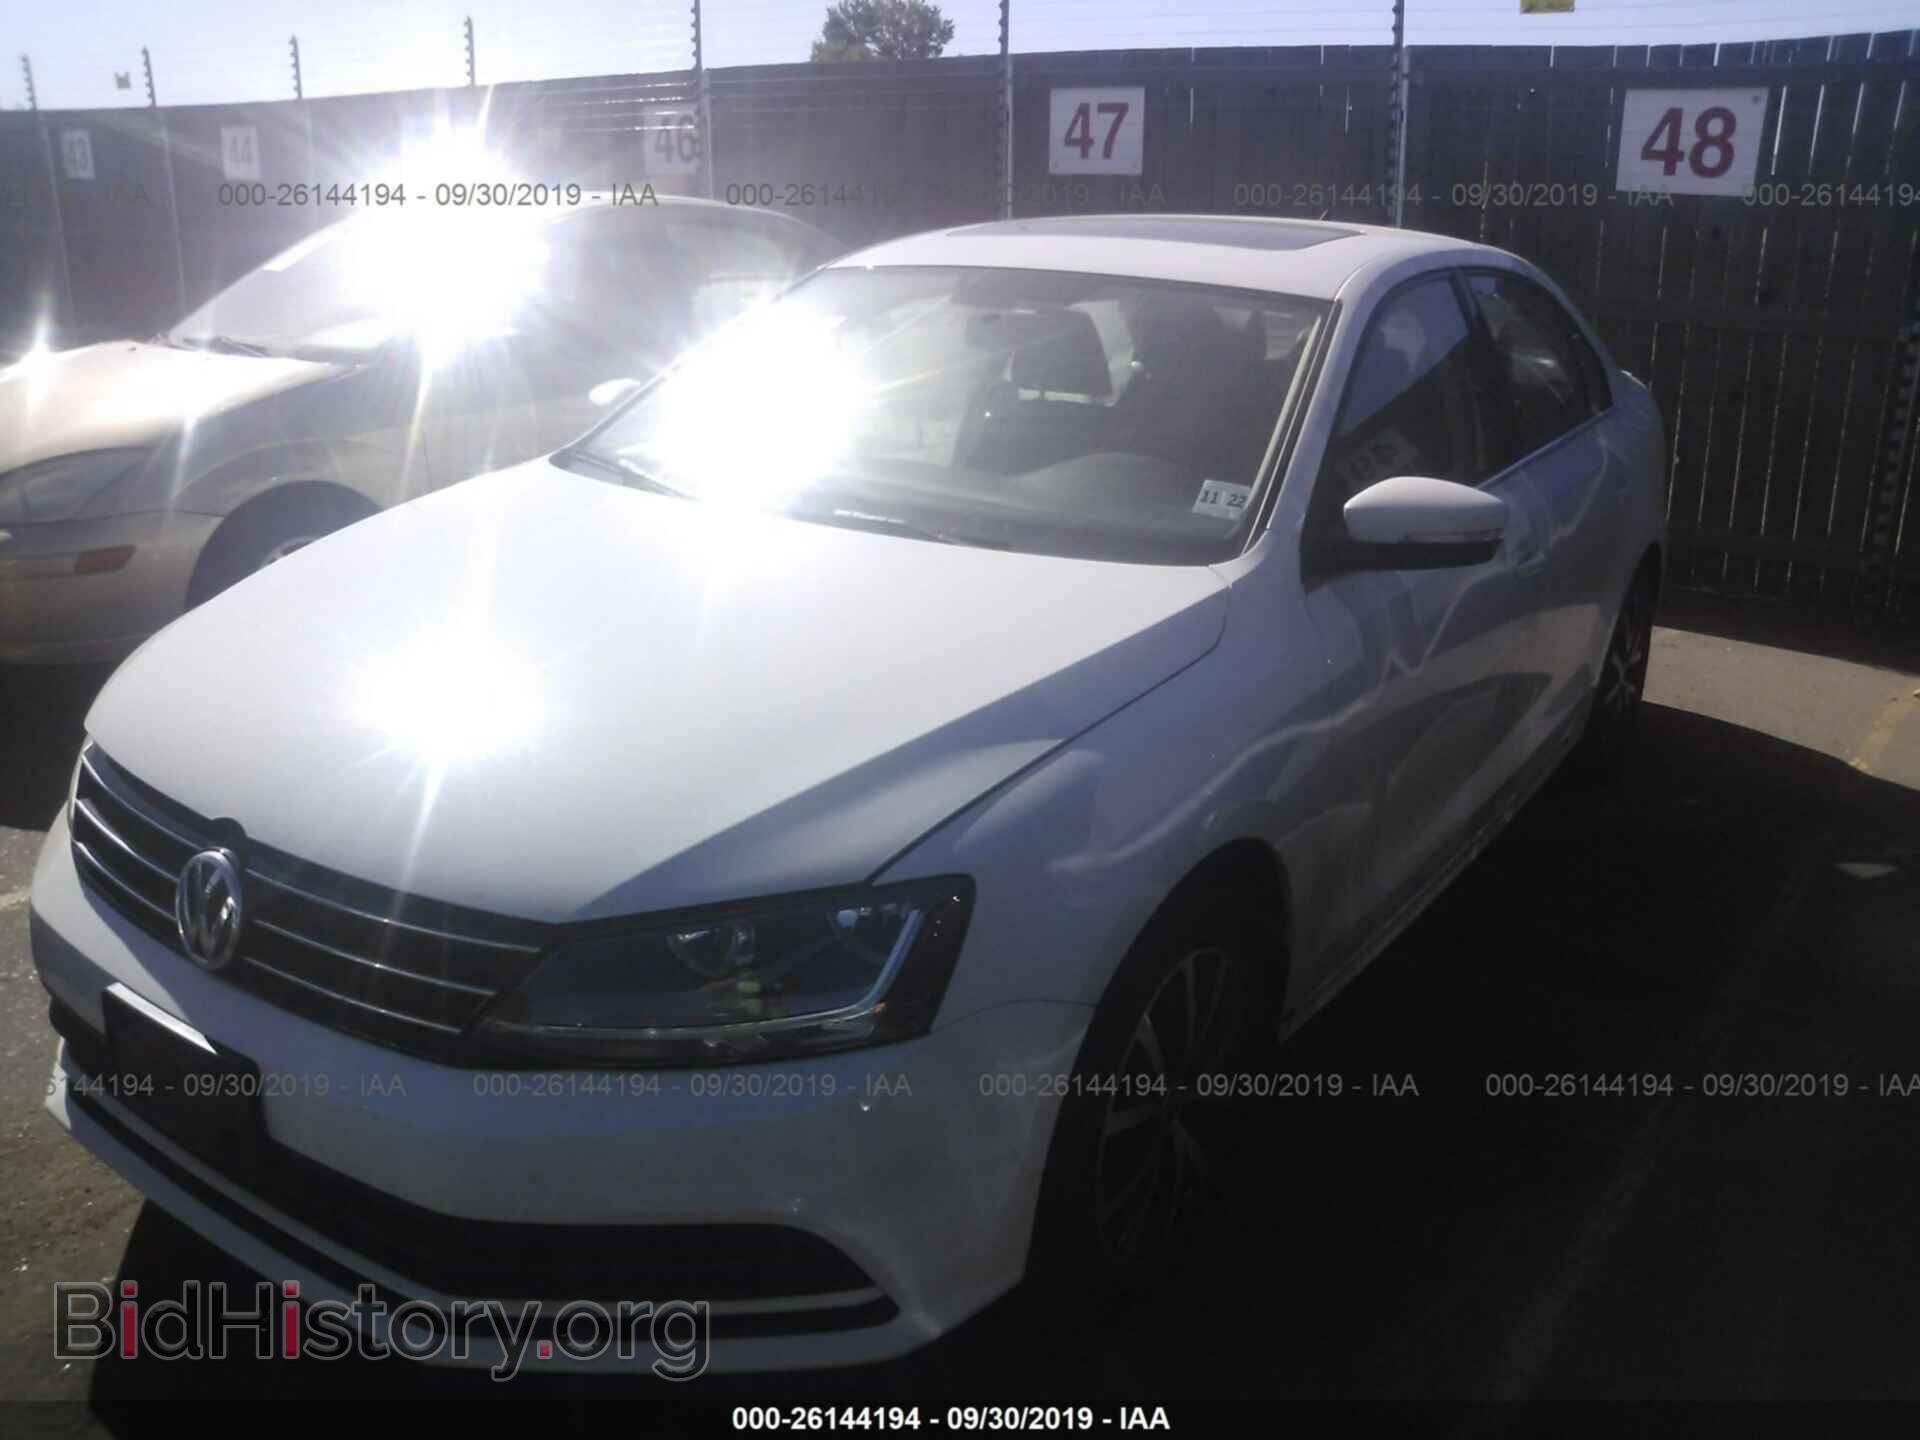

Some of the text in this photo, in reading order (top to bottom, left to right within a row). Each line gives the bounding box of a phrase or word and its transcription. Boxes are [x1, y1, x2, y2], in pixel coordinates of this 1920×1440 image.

[653, 113, 697, 164] 46
[1064, 102, 1129, 160] 47
[1640, 106, 1737, 178] 48
[1200, 490, 1218, 504] 11
